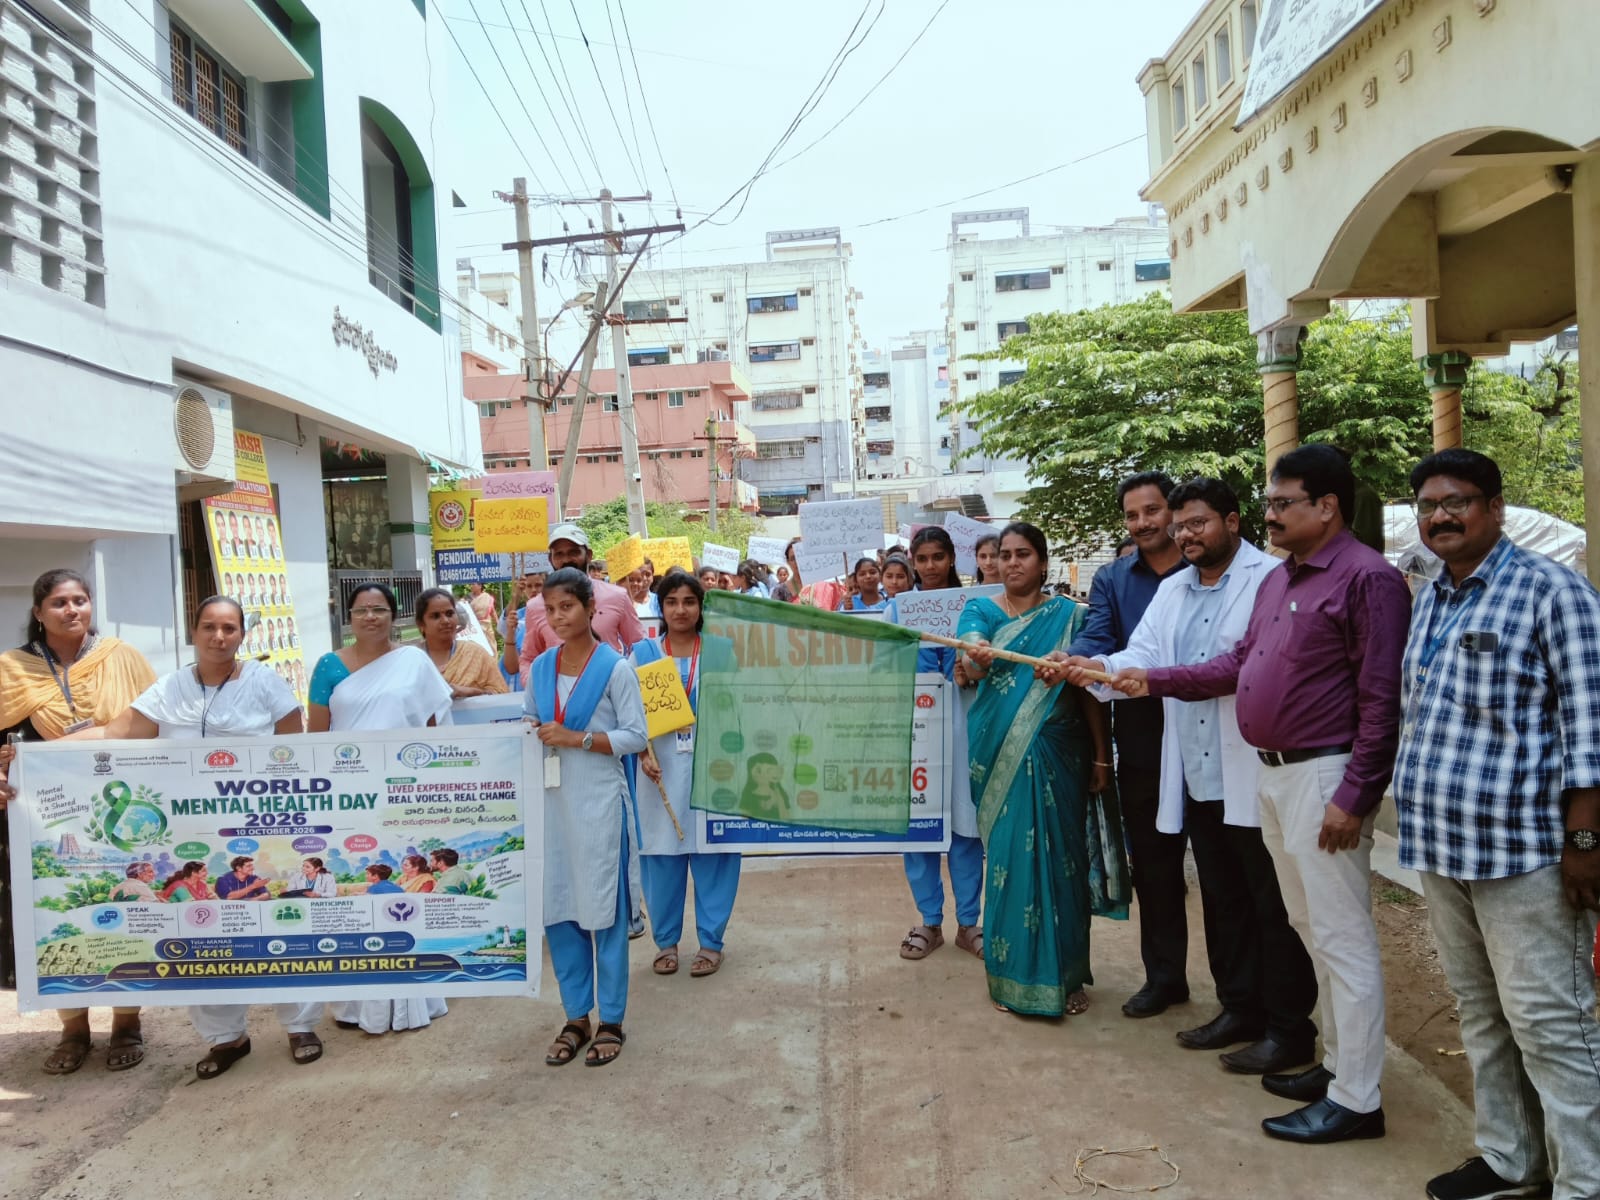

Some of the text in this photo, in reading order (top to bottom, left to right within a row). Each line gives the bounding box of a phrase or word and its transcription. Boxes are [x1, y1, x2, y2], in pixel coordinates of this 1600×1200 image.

[241, 451, 264, 464] COLLEGE
[438, 552, 488, 566] PENDURTHI,
[847, 766, 928, 792] 14416
[36, 784, 63, 798] Mental
[214, 777, 332, 797] WORLD
[387, 780, 516, 794] LIVED EXPERIENCES HEARD:
[41, 793, 65, 804] Health
[51, 797, 76, 810] Shared
[171, 792, 379, 816] MENTAL HEALTH DAY
[388, 791, 517, 804] REAL VOICES, REAL CHANGE
[41, 804, 89, 820] Responsibility
[404, 807, 425, 816] వారి
[427, 806, 452, 815] మాట
[244, 812, 307, 827] 2026
[247, 827, 290, 836] OCTOBER
[194, 948, 233, 958] 14416
[175, 957, 417, 976] VISAKHAPATNAM DISTRICT
